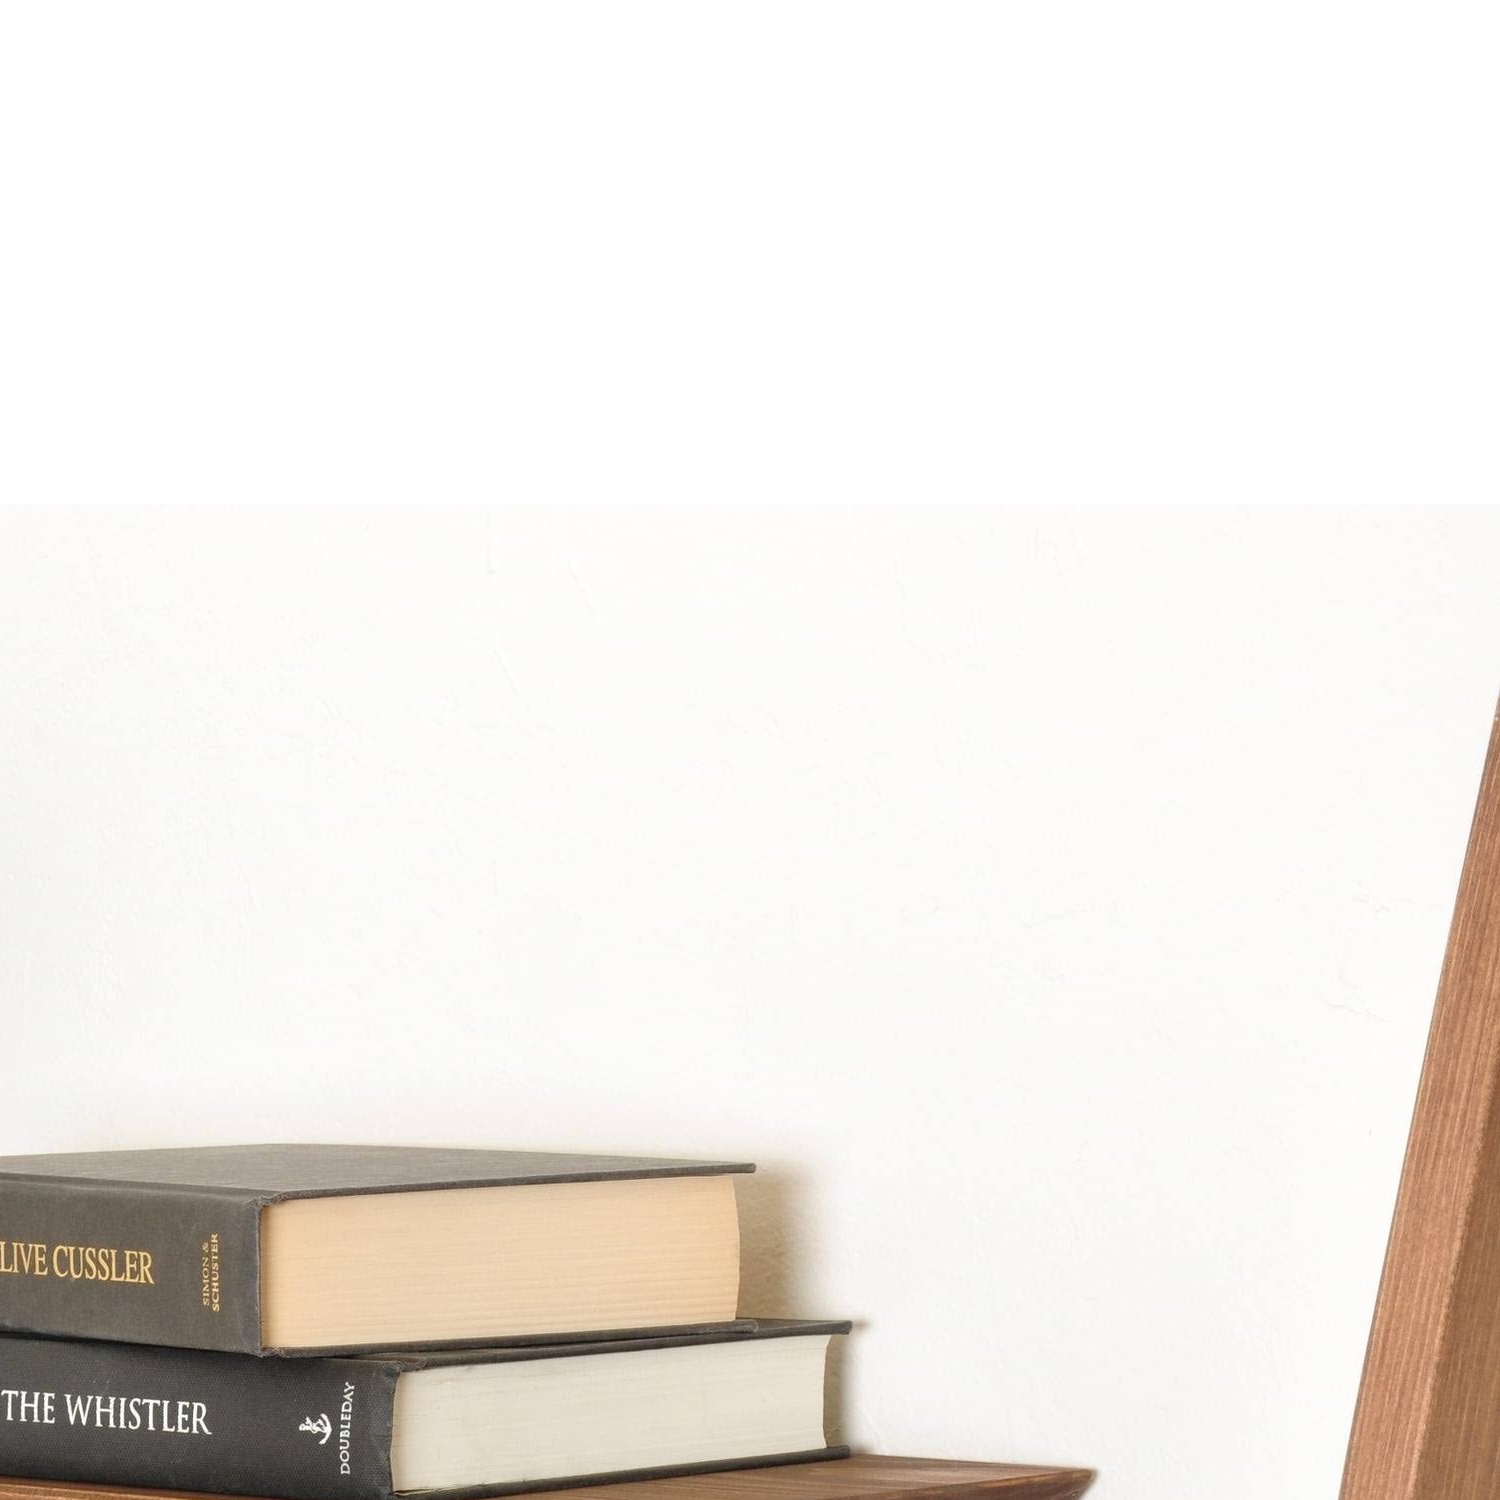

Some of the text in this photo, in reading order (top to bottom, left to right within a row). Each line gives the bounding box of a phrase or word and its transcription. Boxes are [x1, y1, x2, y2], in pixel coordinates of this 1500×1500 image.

[53, 1245, 155, 1285] CUSSLER
[202, 1242, 210, 1306] SIMON &
[211, 1232, 220, 1312] SCHUSTER
[1, 1388, 212, 1435] THE WHISTLER
[340, 1381, 355, 1475] DOUBLEDAY
